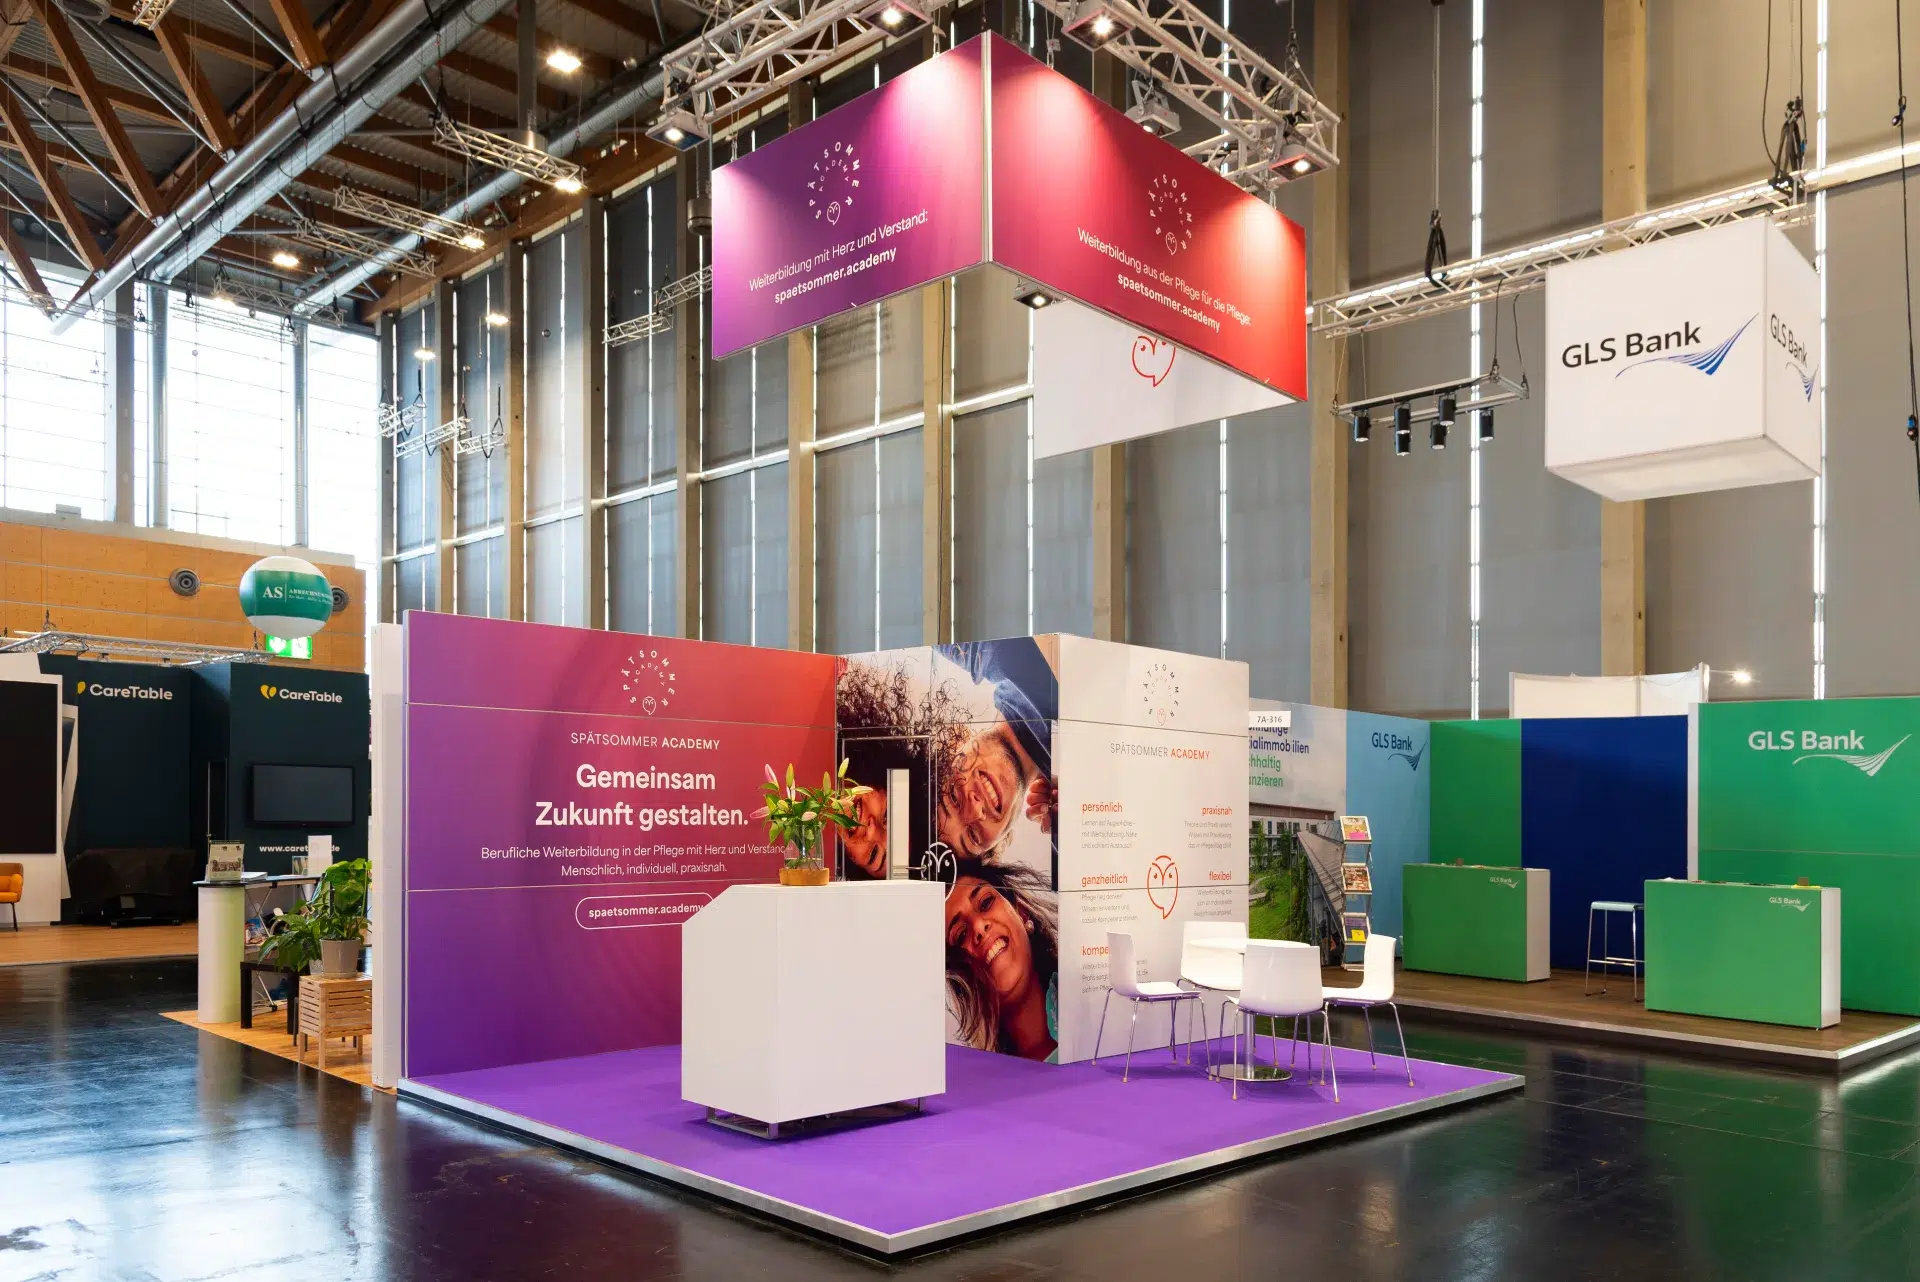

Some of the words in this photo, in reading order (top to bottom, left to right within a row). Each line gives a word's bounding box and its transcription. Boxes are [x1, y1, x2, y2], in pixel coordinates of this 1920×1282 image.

[749, 256, 812, 292] Weiterbildung
[814, 249, 830, 266] mit
[832, 240, 855, 259] Herz
[857, 229, 877, 249] und
[878, 209, 929, 240] Verstand:
[774, 247, 897, 304] spaetsommer.academy
[1077, 226, 1142, 274] Weiterbildung
[1143, 262, 1158, 280] aus
[1159, 269, 1173, 286] der
[1175, 276, 1201, 301] Pflege
[1201, 288, 1214, 305] für
[1213, 297, 1226, 313] die
[1117, 273, 1221, 334] spaetsommer.academy
[1562, 337, 1617, 368] GLS
[1626, 321, 1701, 357] Bank
[1770, 313, 1787, 348] GLS
[1788, 330, 1808, 369] Bank
[262, 586, 284, 599] AS
[621, 649, 676, 707] SPÄTSOMMER
[90, 683, 173, 701] CareTable
[279, 688, 343, 704] CareTable
[1257, 715, 1283, 724] 7A-316
[570, 731, 658, 748] SPÄTSOMMER
[661, 737, 720, 750] ACADEMY
[1249, 736, 1310, 754] ialimmobilien
[1371, 732, 1389, 750] GLS
[1391, 733, 1413, 752] Bank
[1748, 730, 1795, 752] GLS
[1801, 729, 1865, 751] Bank
[1109, 741, 1169, 758] SPÄTSOMMER
[1170, 748, 1210, 760] ACADEMY
[1249, 753, 1281, 772] hhaltig
[576, 763, 716, 790] Gemeinsam
[1249, 773, 1284, 788] nzieren
[535, 801, 634, 826] Zukunft
[639, 803, 749, 831] gestalten.
[1082, 801, 1123, 815] persönlich
[1202, 805, 1232, 816] praxisnah
[259, 845, 340, 853] www.caretde
[481, 847, 541, 860] Berufliche
[543, 845, 620, 861] Weiterbildung
[622, 845, 631, 857] in
[633, 844, 651, 857] der
[653, 844, 685, 859] Pflege
[686, 843, 703, 856] mit
[704, 844, 726, 856] Herz
[728, 843, 746, 855] und
[561, 863, 625, 877] Menschlich,
[626, 862, 679, 876] individuell,
[680, 861, 727, 875] praxisnah.
[1209, 870, 1232, 881] flexibel
[1081, 873, 1128, 888] ganzheitlich
[1769, 896, 1783, 904] GLS
[1082, 945, 1109, 957] kompe
